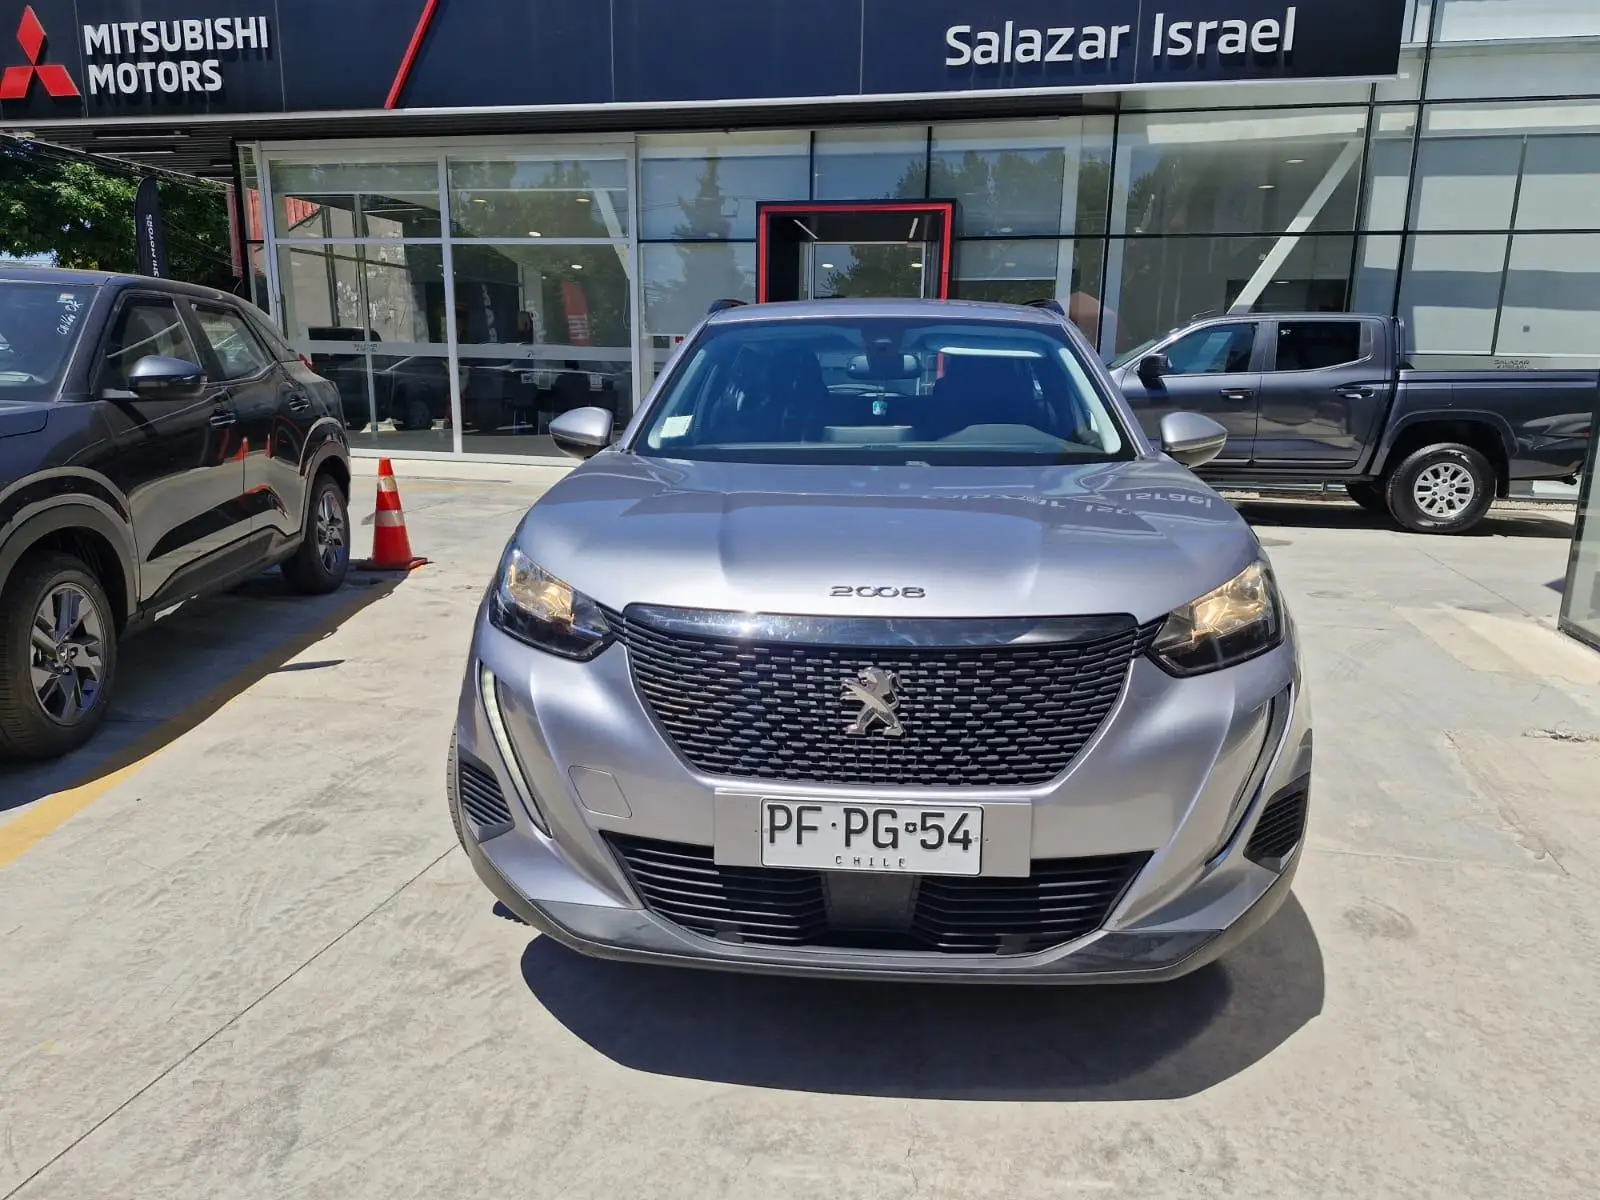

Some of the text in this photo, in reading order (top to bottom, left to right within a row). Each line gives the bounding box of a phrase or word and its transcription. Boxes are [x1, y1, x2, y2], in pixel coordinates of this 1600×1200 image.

[83, 16, 269, 56] MITSUBISHI
[945, 6, 1296, 66] Salazar Israel
[88, 59, 223, 95] MOTORS
[830, 586, 926, 599] 2008
[835, 855, 906, 867] CHILE
